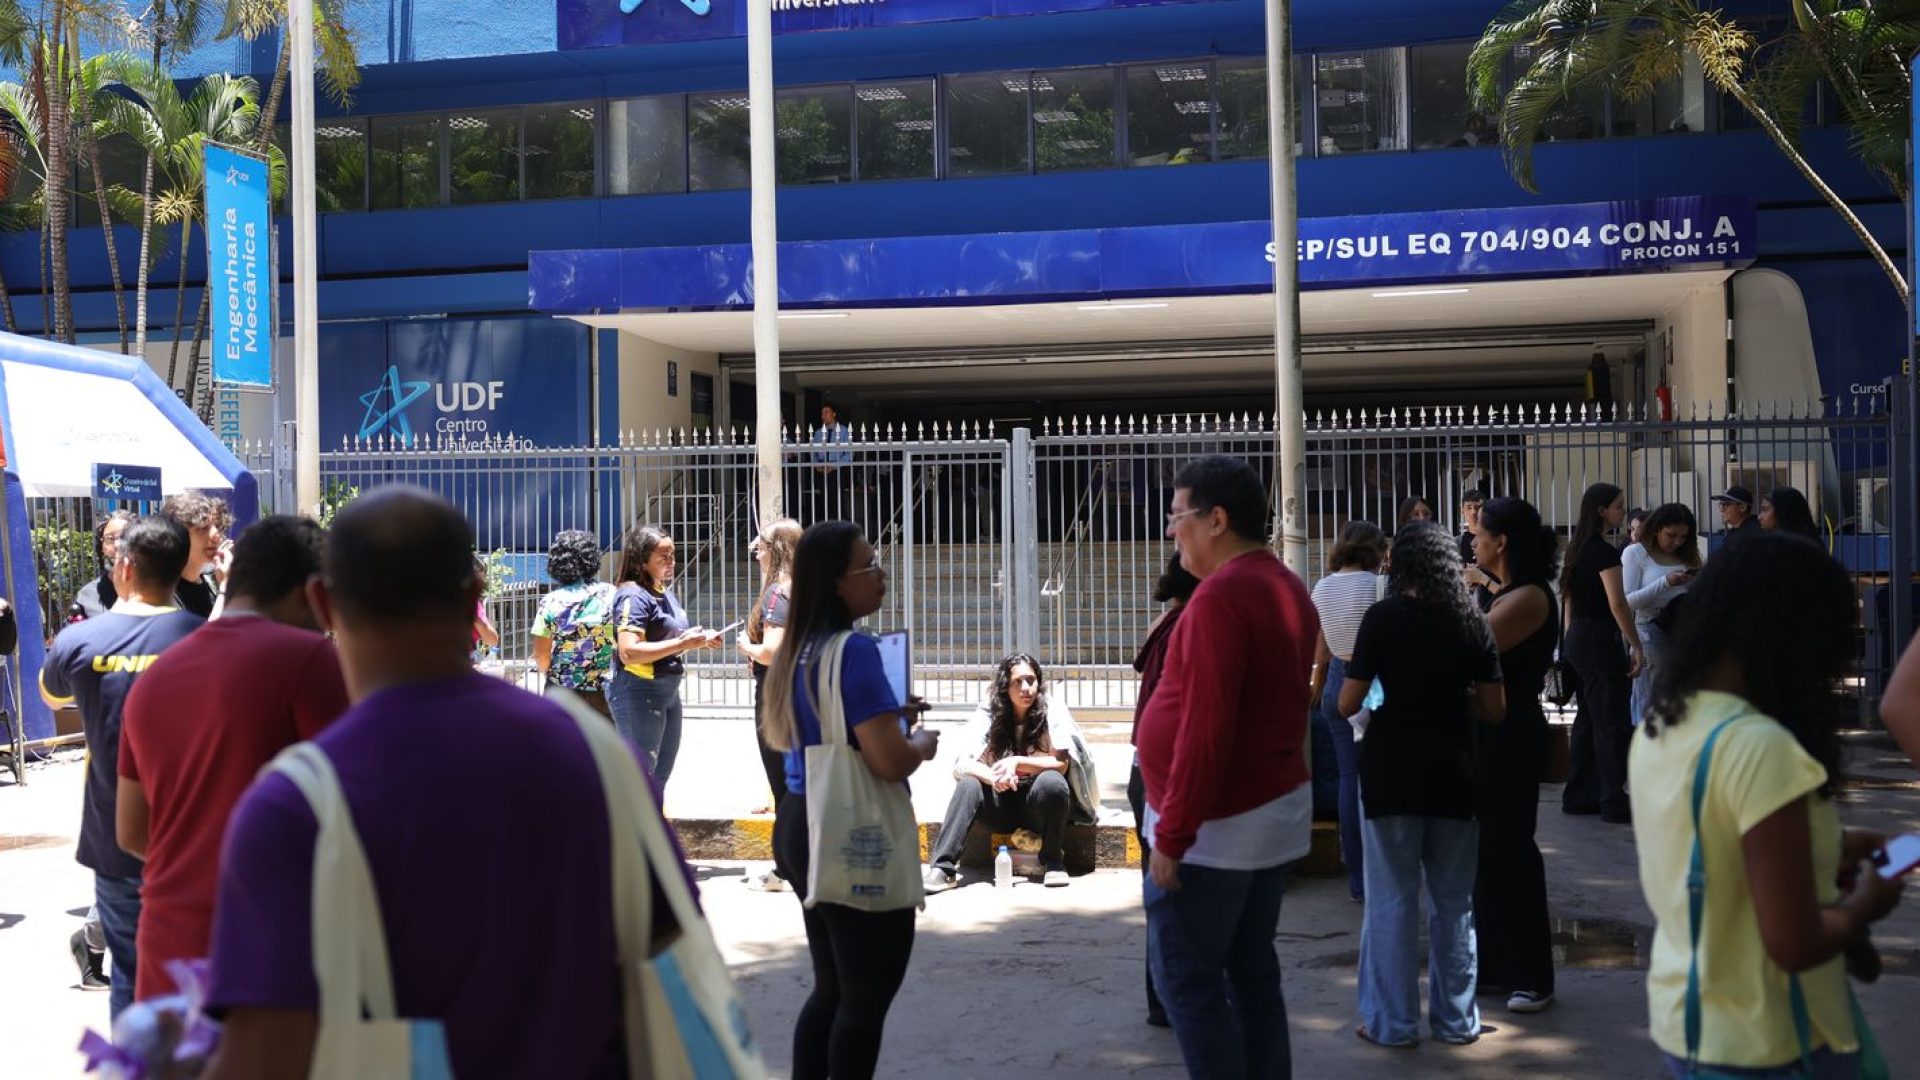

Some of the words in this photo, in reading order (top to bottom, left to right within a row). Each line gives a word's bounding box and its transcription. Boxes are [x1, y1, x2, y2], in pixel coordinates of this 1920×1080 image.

[1408, 233, 1451, 255] EQ
[1461, 226, 1592, 253] 704/904
[1600, 218, 1703, 246] CONJ.
[1713, 215, 1736, 238] A
[1621, 243, 1700, 260] PROCON
[1706, 241, 1740, 255] 151
[223, 207, 243, 361] Engenharia
[243, 221, 258, 353] Mecânica
[435, 380, 505, 413] UDF
[435, 417, 487, 433] Centro
